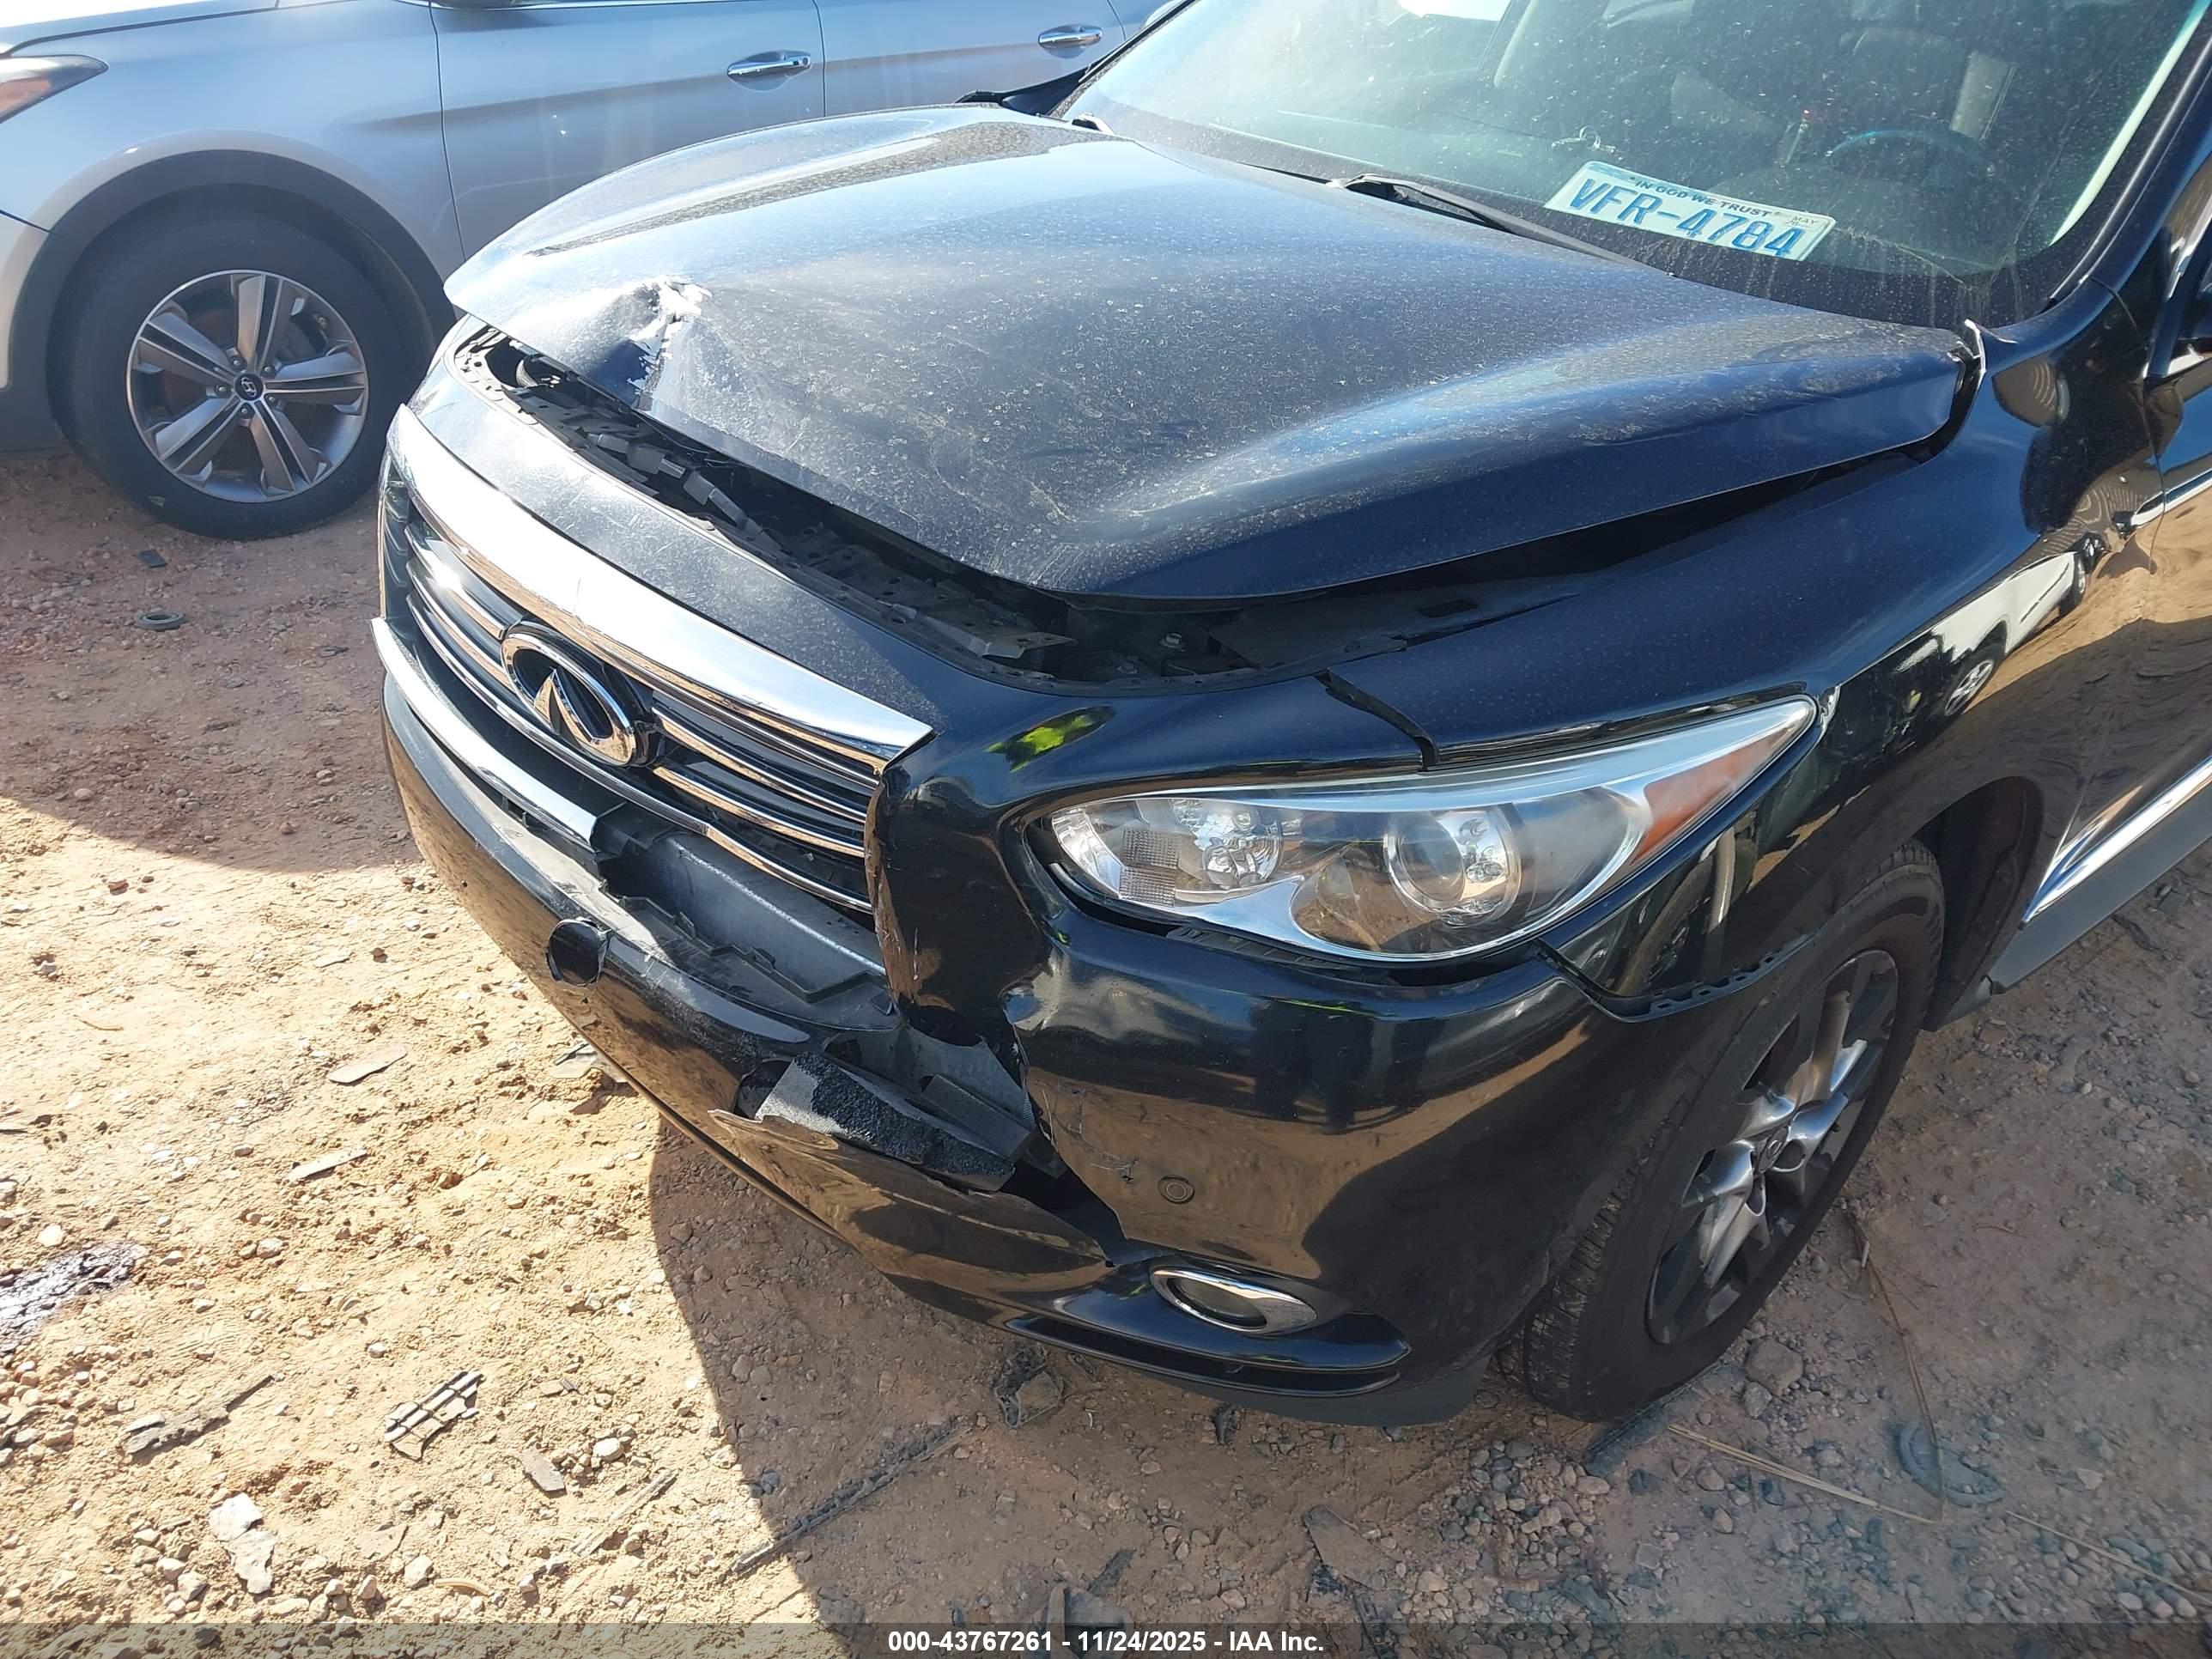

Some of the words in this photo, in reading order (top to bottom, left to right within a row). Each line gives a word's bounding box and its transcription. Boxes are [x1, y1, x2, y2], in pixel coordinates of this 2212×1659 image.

[1569, 178, 1806, 257] VFR-4784
[1634, 179, 1653, 190] IN
[1656, 185, 1688, 198] GOD
[1692, 194, 1717, 206] WE
[1720, 202, 1771, 218] TRUST
[1791, 216, 1819, 226] MAY
